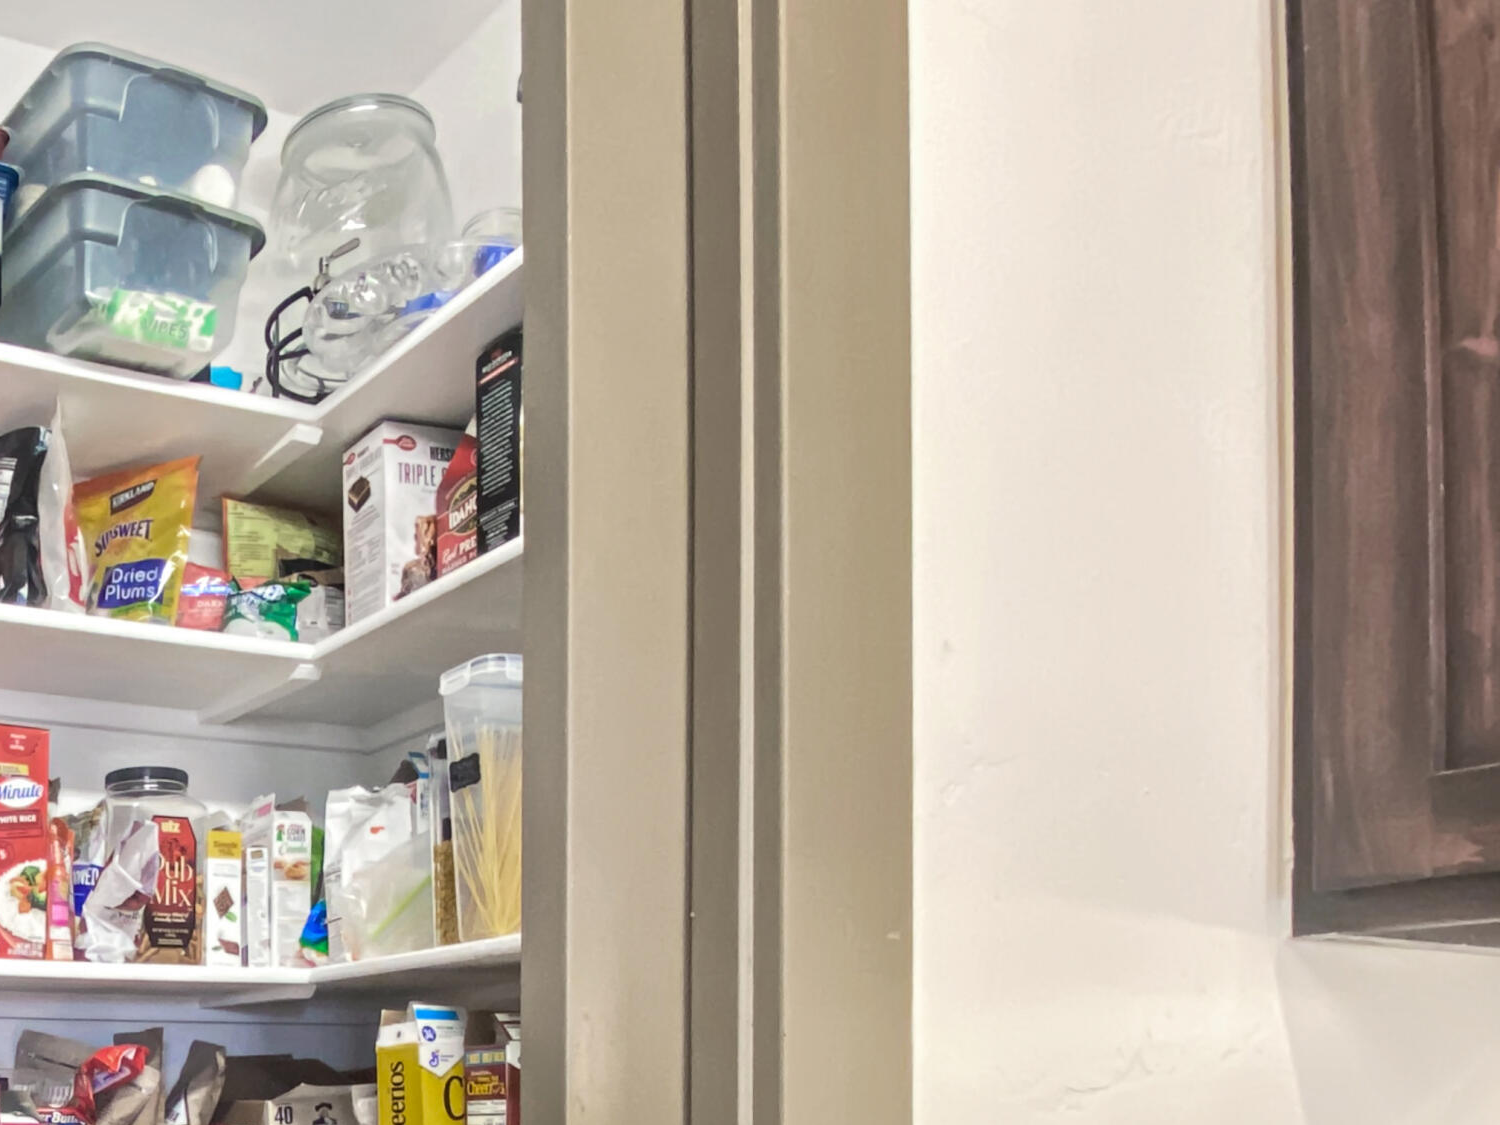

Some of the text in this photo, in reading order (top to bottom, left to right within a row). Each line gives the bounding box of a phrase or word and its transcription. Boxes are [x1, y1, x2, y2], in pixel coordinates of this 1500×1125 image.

[397, 462, 438, 488] TRIPLE
[112, 566, 159, 584] Dried
[104, 584, 157, 601] Plums
[19, 814, 37, 823] RICE
[160, 821, 181, 833] utz
[275, 1105, 294, 1125] 40
